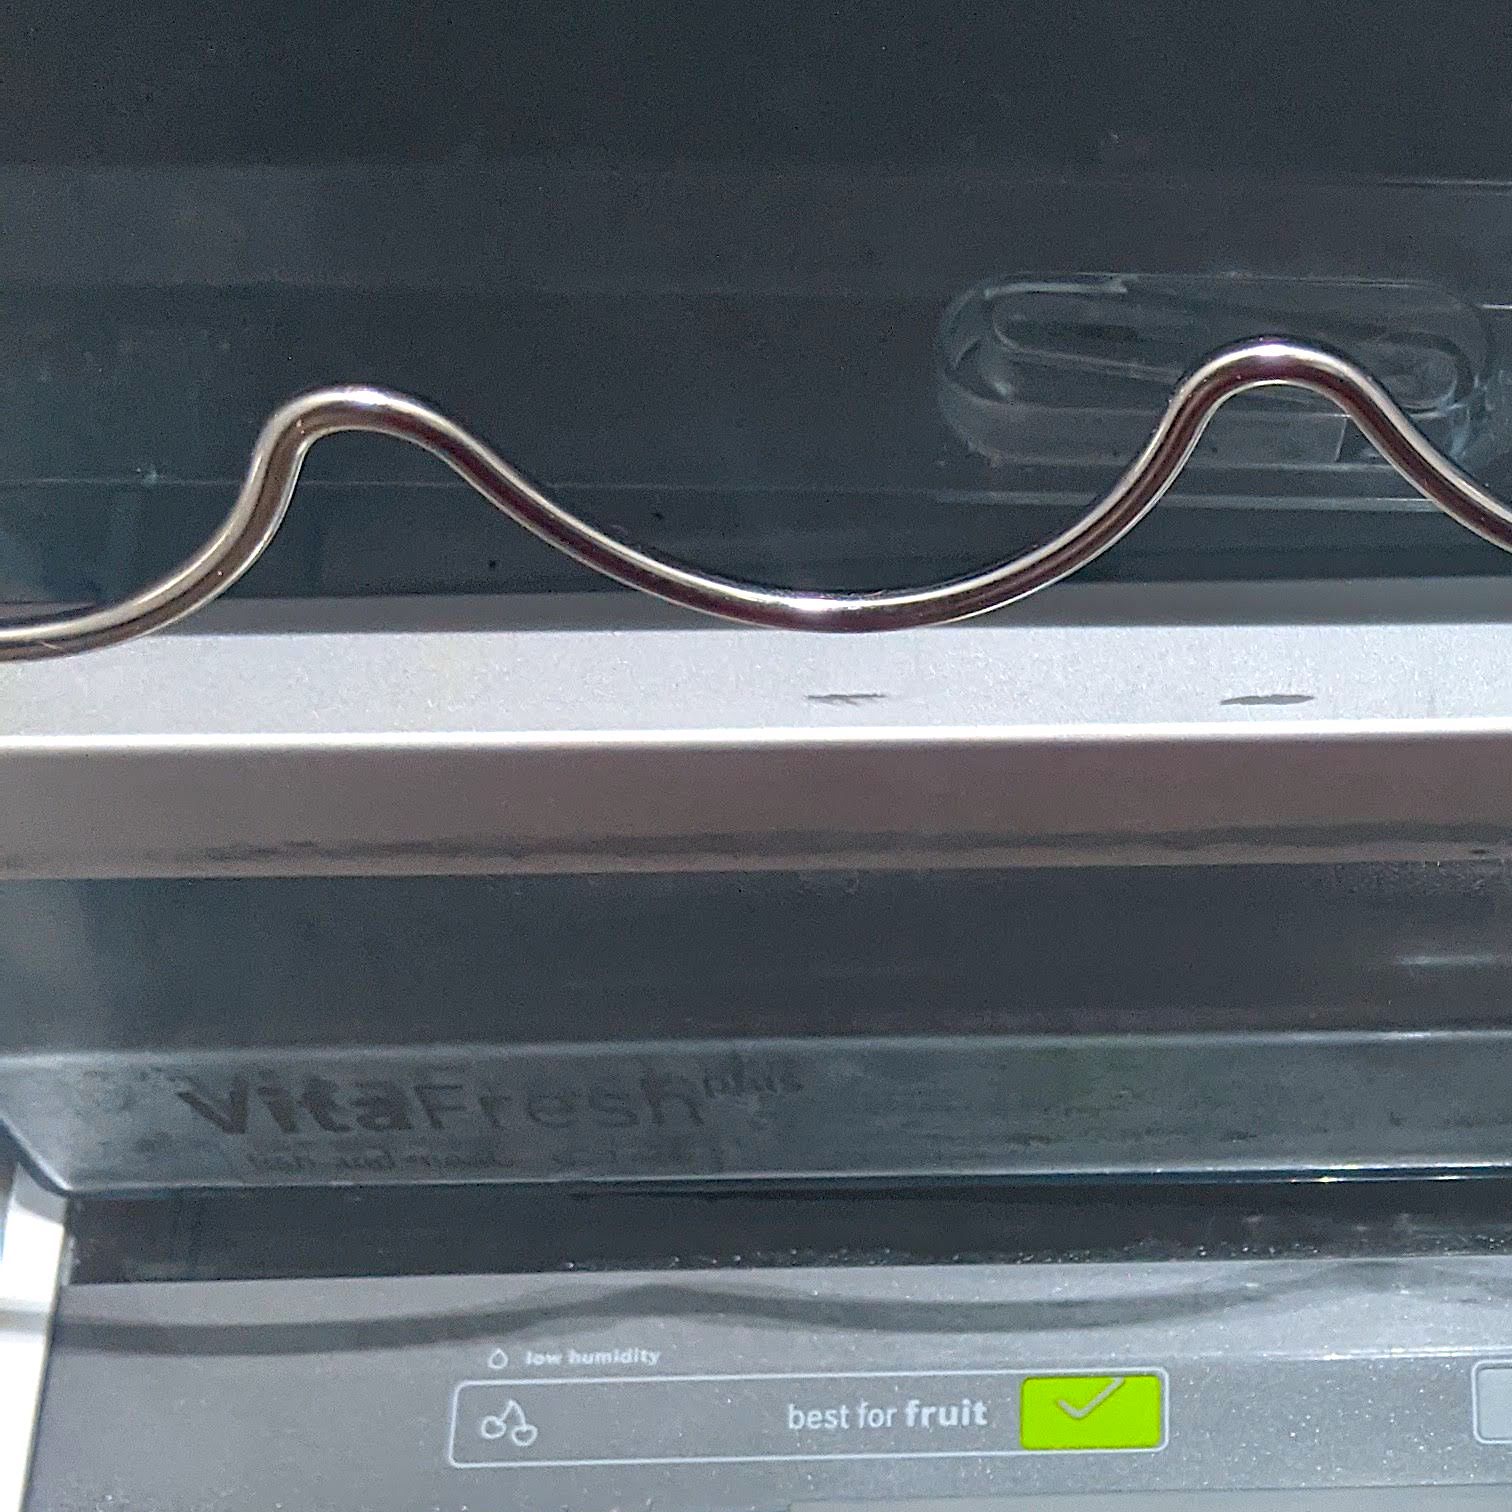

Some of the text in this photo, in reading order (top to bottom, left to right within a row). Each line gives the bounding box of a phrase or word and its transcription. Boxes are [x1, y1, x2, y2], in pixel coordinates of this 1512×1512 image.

[526, 1348, 661, 1366] low humidity
[787, 1399, 988, 1429] best for fruit
